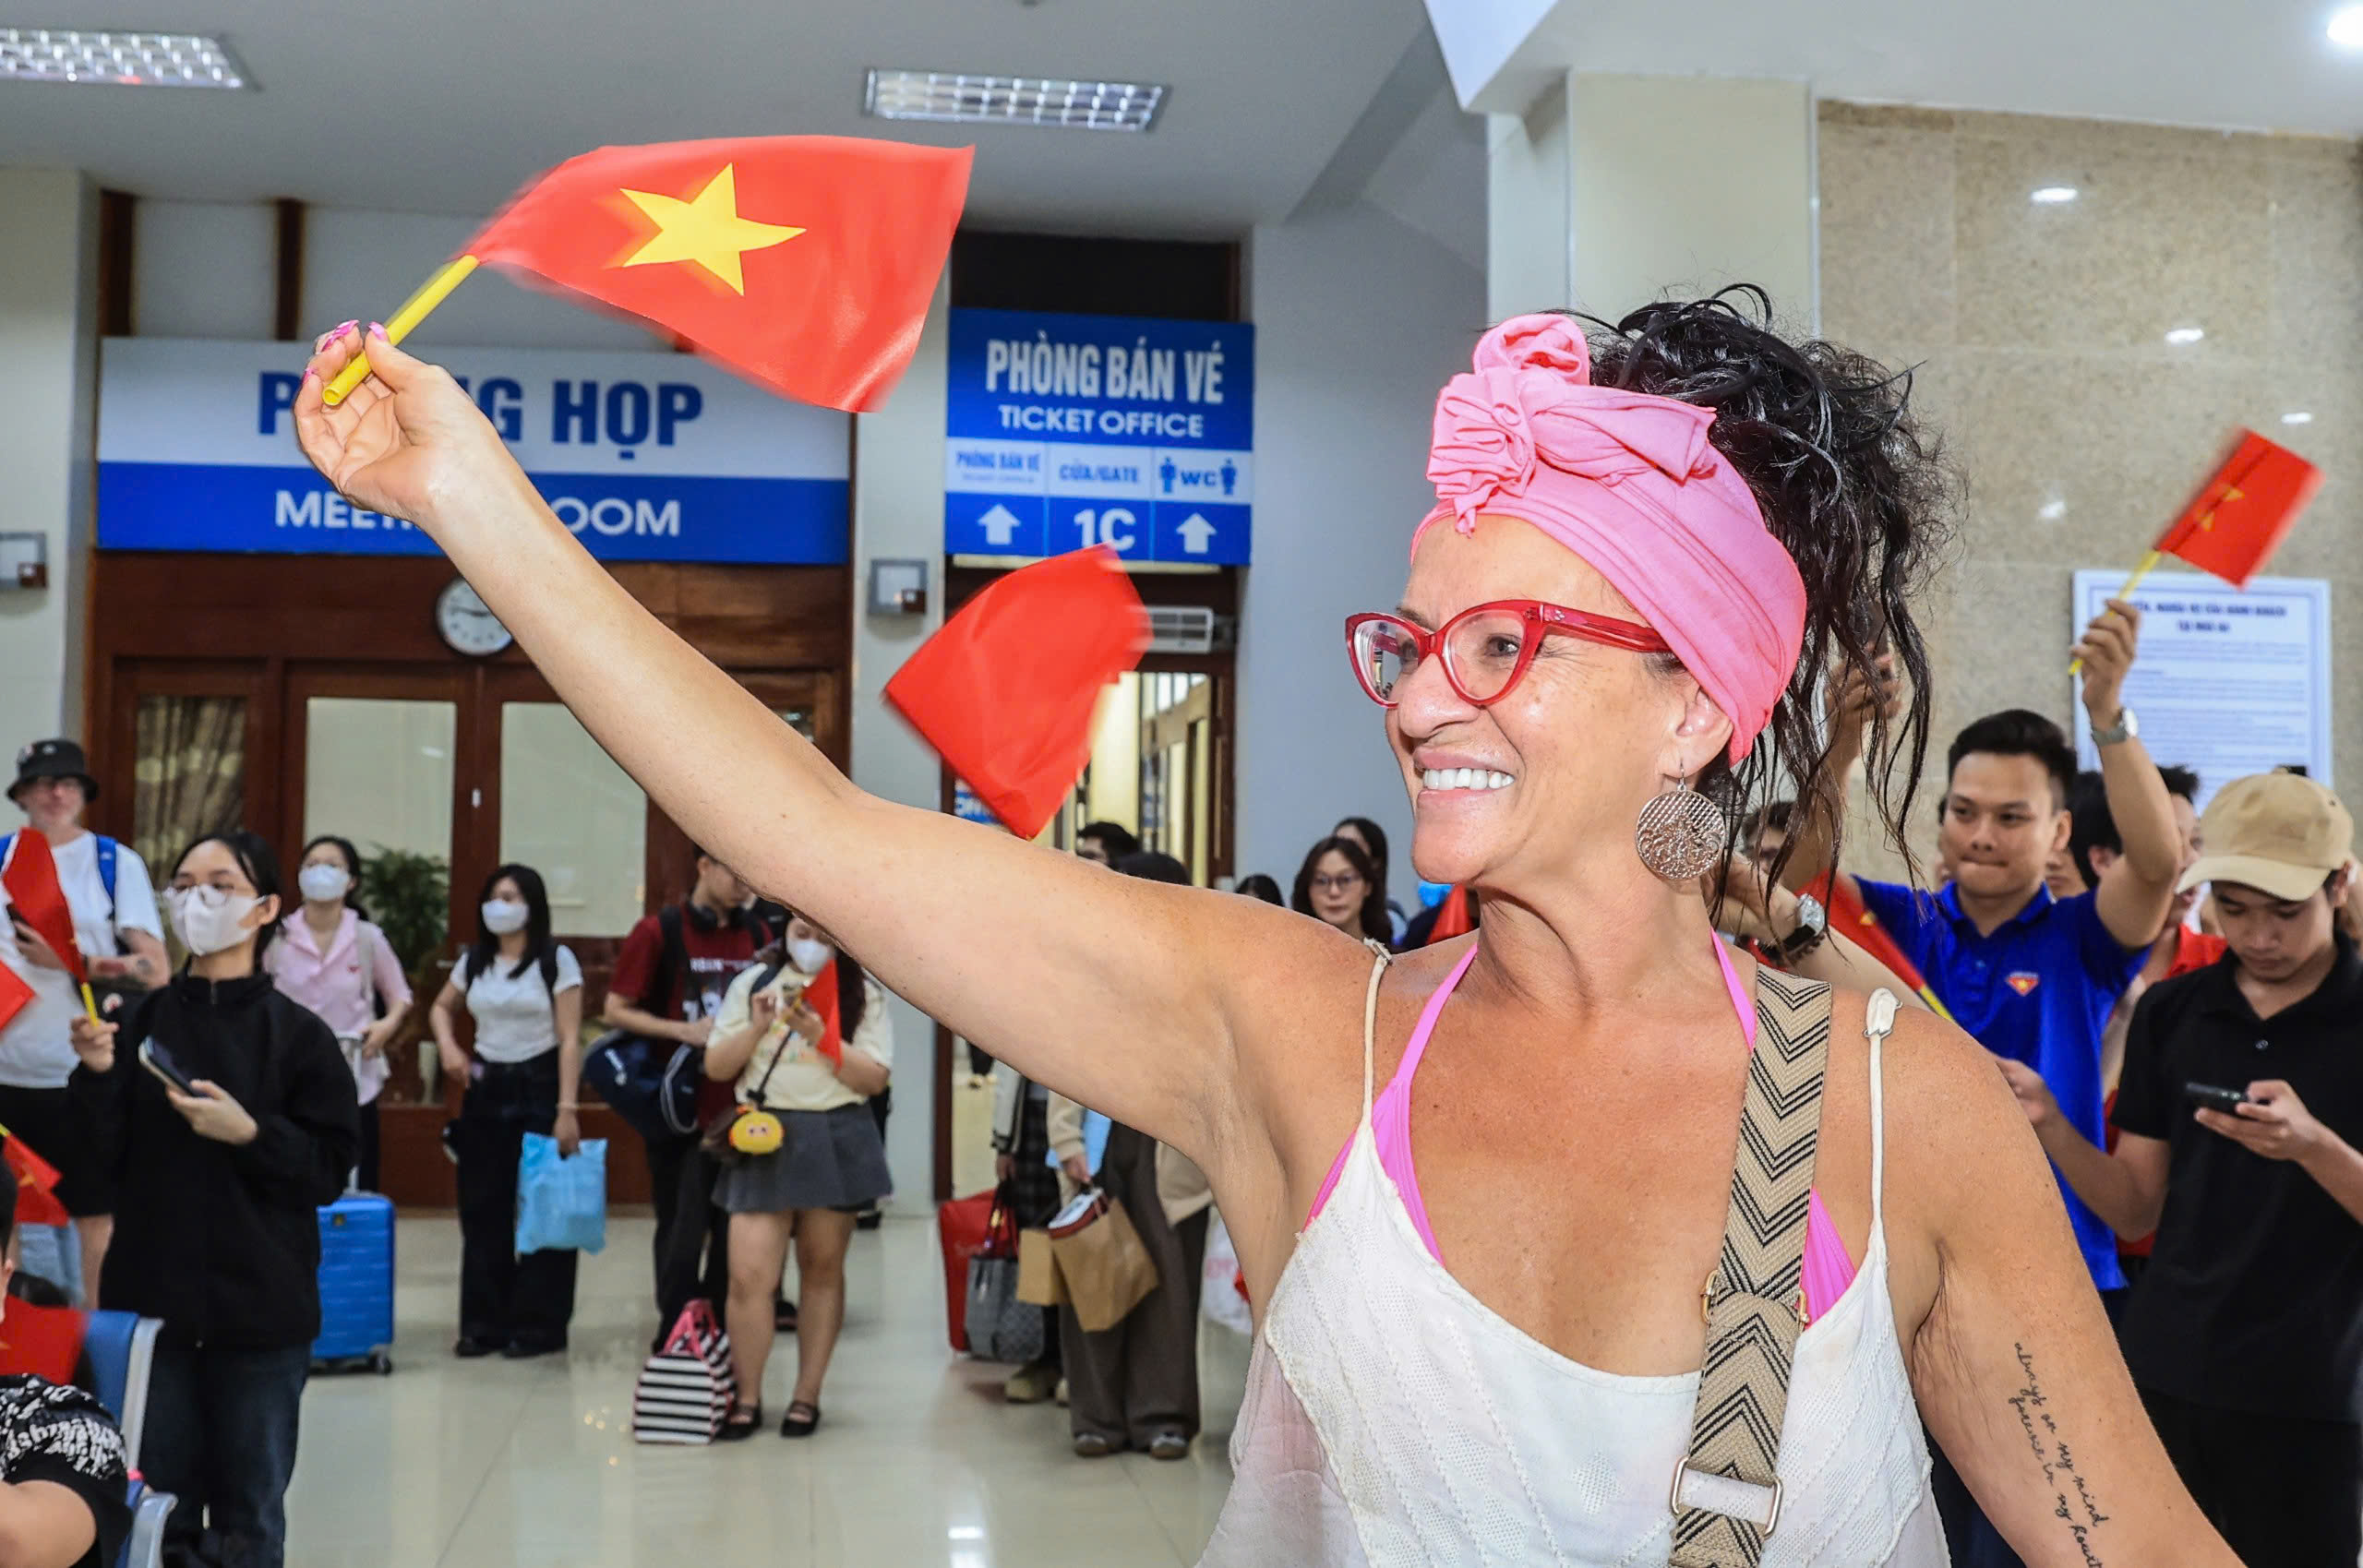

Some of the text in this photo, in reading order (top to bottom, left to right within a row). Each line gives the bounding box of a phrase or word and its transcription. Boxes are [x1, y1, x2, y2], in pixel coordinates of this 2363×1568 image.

[987, 329, 1224, 404] PHÒNG BÁN VÉ
[552, 378, 704, 460] HỌP
[998, 404, 1205, 437] TICKET OFFICE
[1181, 470, 1217, 487] WC
[1074, 508, 1136, 552] 1C
[2014, 1342, 2109, 1527] always on my mind
[2055, 1492, 2074, 1522] my
